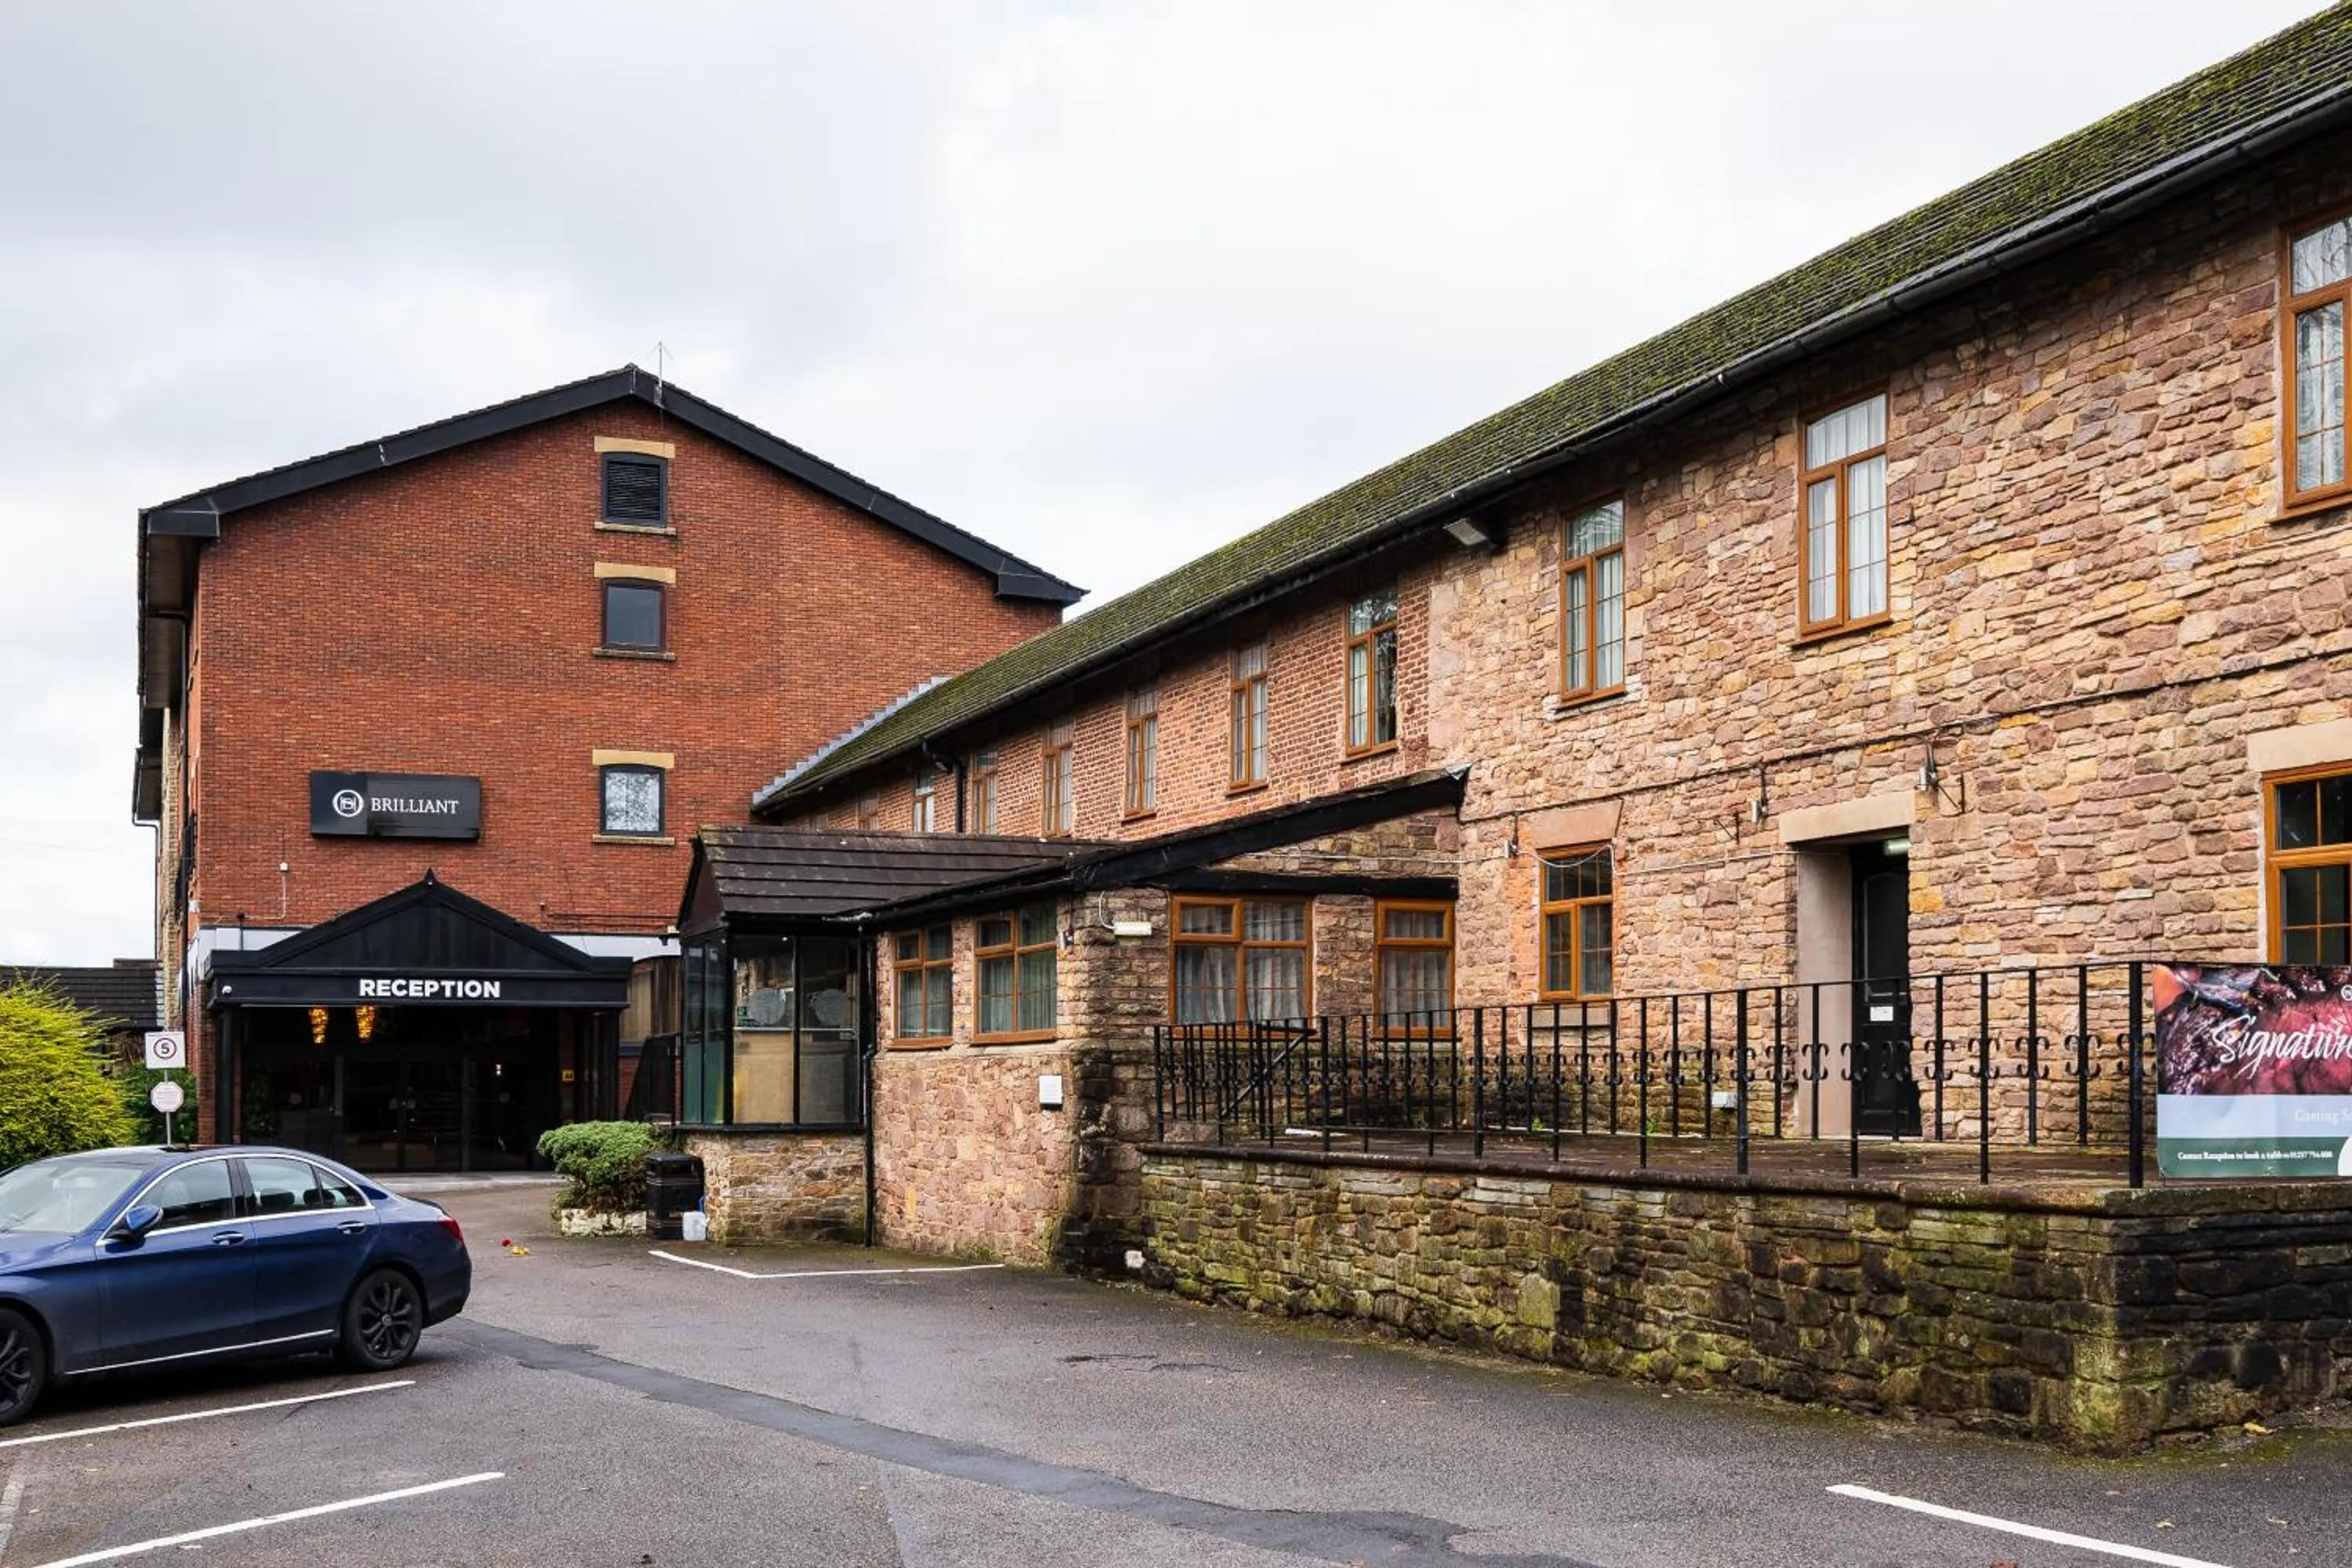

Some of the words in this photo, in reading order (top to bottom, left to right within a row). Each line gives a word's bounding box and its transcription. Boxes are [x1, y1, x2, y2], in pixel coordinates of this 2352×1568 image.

[371, 797, 459, 815] BRILLIANT
[359, 978, 501, 998] RECEPTION
[161, 1042, 170, 1054] 5
[2295, 1109, 2338, 1125] Coming
[2204, 1152, 2234, 1163] Reception
